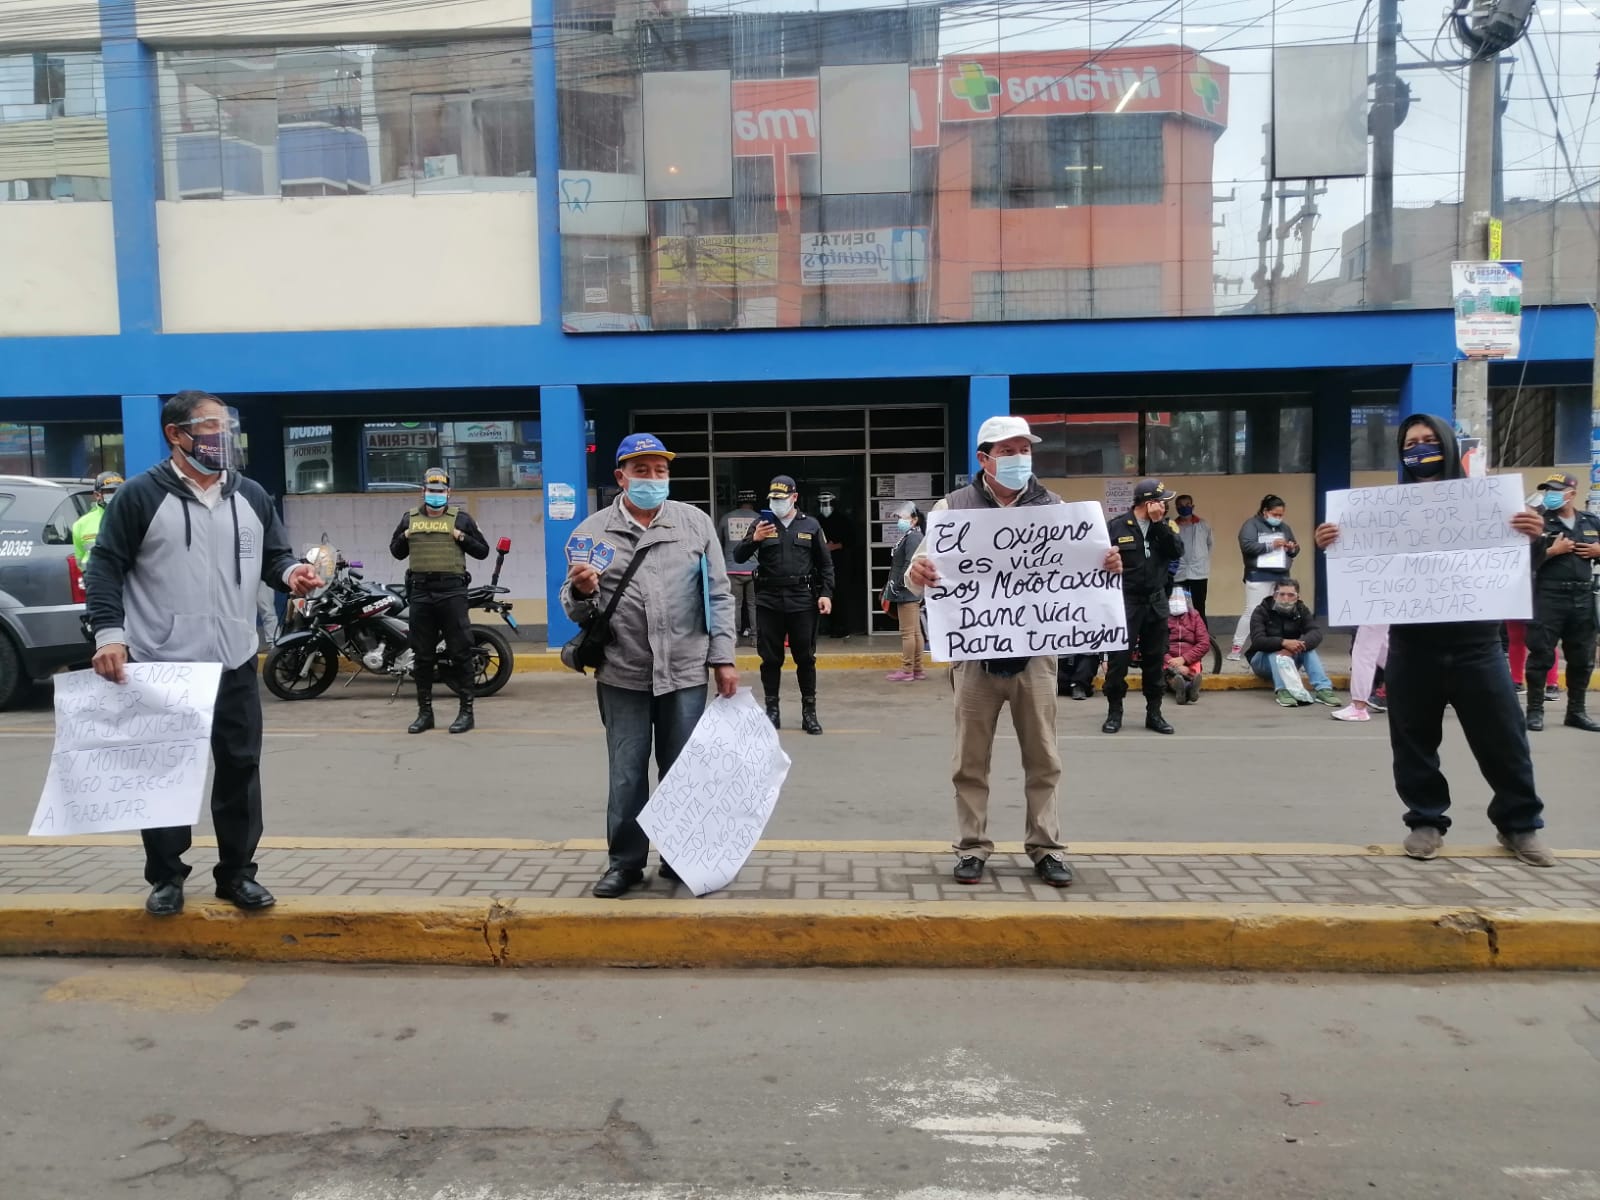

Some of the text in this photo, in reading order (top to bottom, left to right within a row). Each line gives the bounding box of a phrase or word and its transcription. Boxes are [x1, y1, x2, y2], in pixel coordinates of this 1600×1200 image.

[1348, 486, 1423, 506] GRACIAS
[411, 521, 449, 531] POLICIA
[1338, 502, 1502, 529] ALCALDE POR LA
[935, 521, 970, 554] El
[1404, 528, 1430, 548] DE
[958, 548, 1064, 574] es vida
[1342, 550, 1520, 577] SOY MOTOTAXISTA
[1358, 574, 1509, 597] TENGO DERECHO
[959, 606, 1026, 630] Dame
[1337, 600, 1351, 622] A
[164, 689, 190, 708] LA
[650, 738, 705, 813] GRACIAS
[651, 706, 743, 841] ALCALDE POR LA
[38, 806, 55, 830] A
[662, 796, 704, 851] PLANTA
[703, 769, 721, 798] DE
[681, 823, 706, 866] SOY
[696, 816, 736, 870] TENGO
